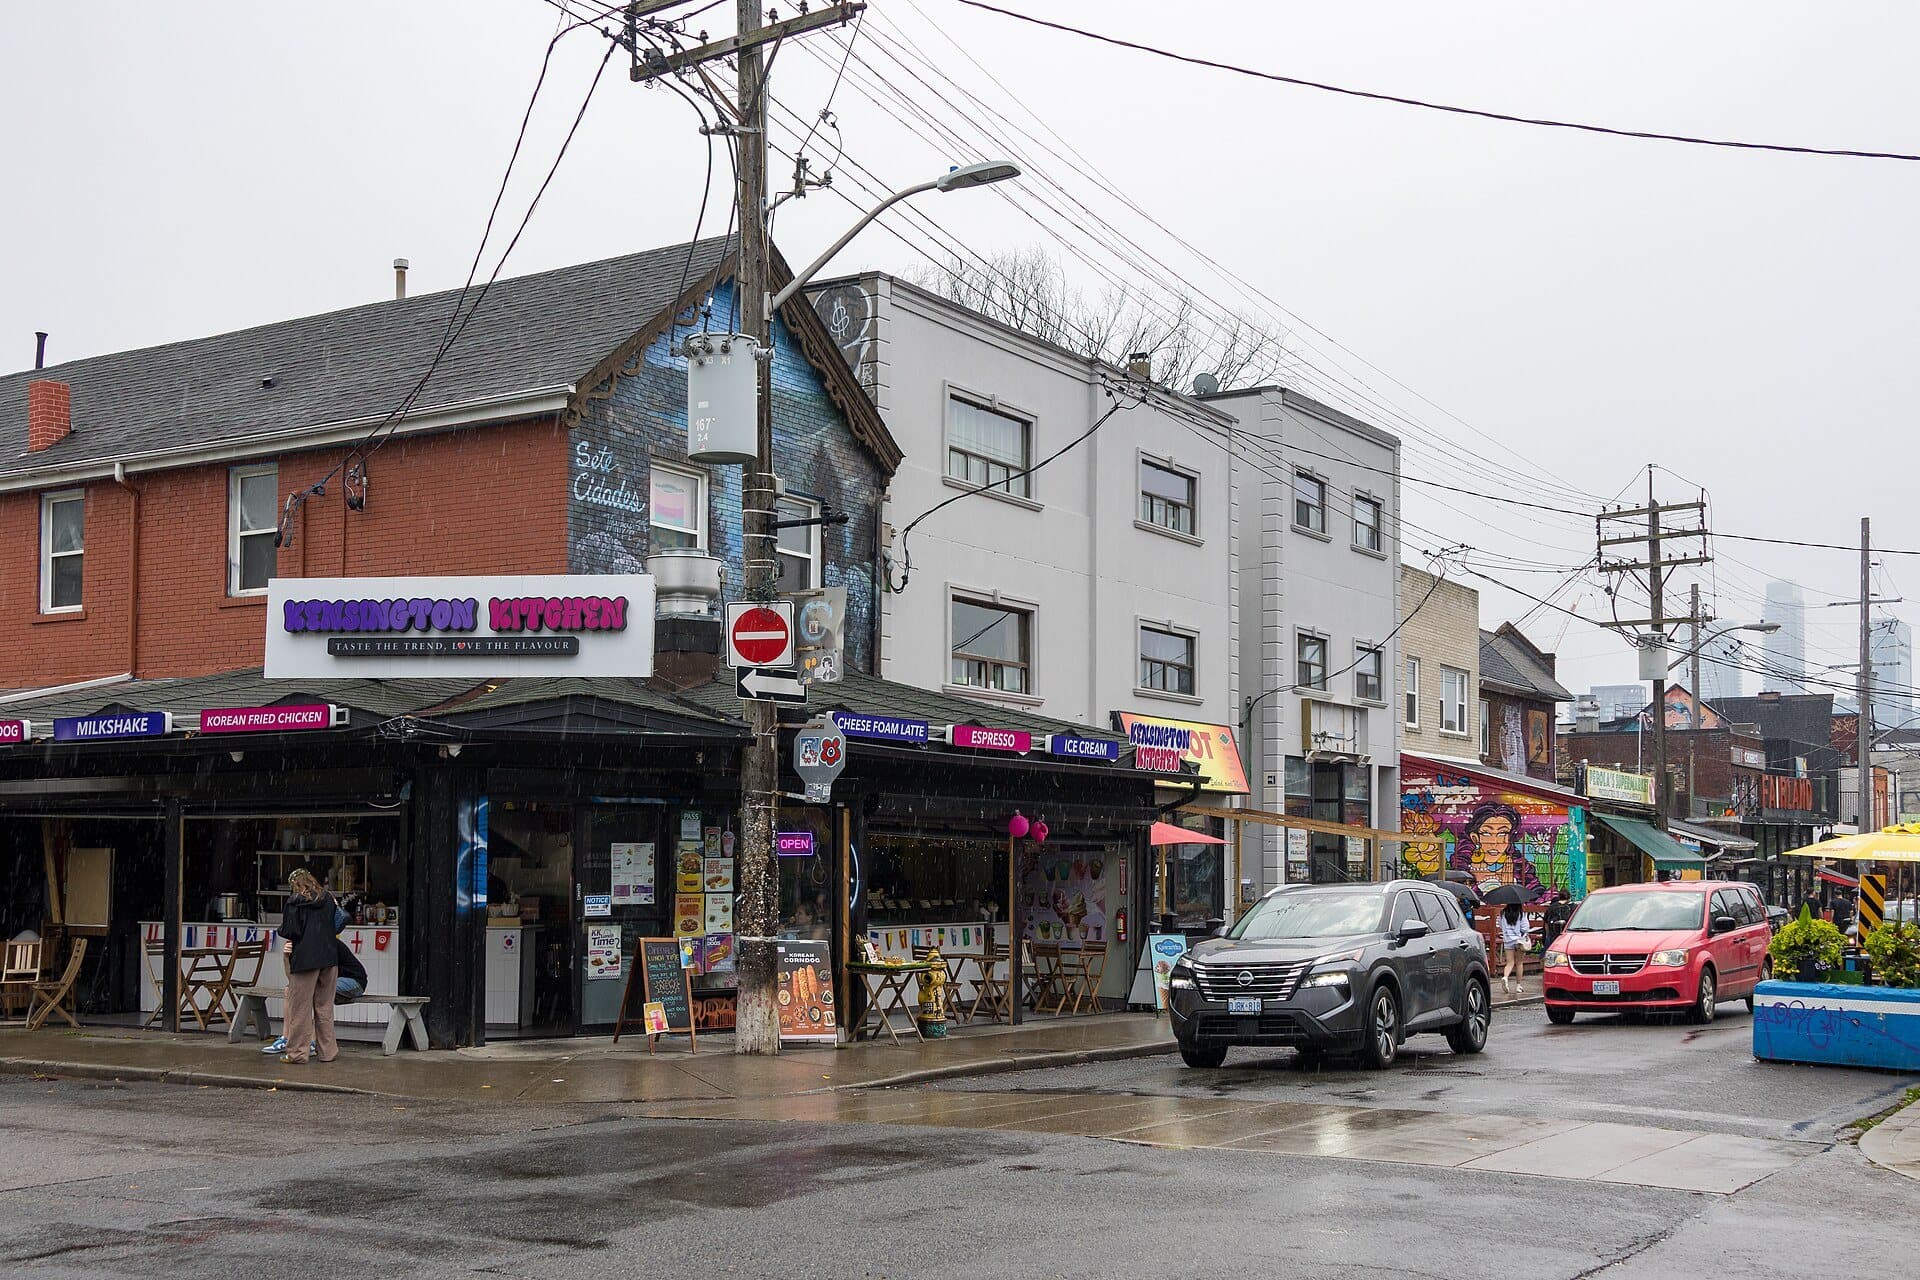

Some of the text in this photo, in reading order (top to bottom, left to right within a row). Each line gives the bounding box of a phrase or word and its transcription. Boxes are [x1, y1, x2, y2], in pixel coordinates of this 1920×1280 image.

[576, 441, 619, 472] Sete
[573, 472, 646, 513] Cidades
[283, 596, 629, 633] KENSINGTON KITCHEN
[335, 642, 371, 651] TASTE
[376, 642, 399, 651] THE
[404, 642, 447, 652] TREND,
[486, 641, 510, 650] THE
[515, 641, 570, 650] FLAVOUR
[76, 717, 149, 736] MILKSHAKE
[206, 711, 322, 727] KOREAN FRIED CHICKEN
[837, 717, 925, 737] CHEESE FOAM LATTE
[971, 730, 1015, 748] ESPRESSO
[1129, 721, 1191, 749] KENSINGTON
[1063, 739, 1108, 756] ICE CREAM
[1135, 745, 1180, 772] KITCHEN
[684, 812, 700, 820] PASS
[780, 839, 809, 849] OPEN
[592, 937, 615, 946] Time
